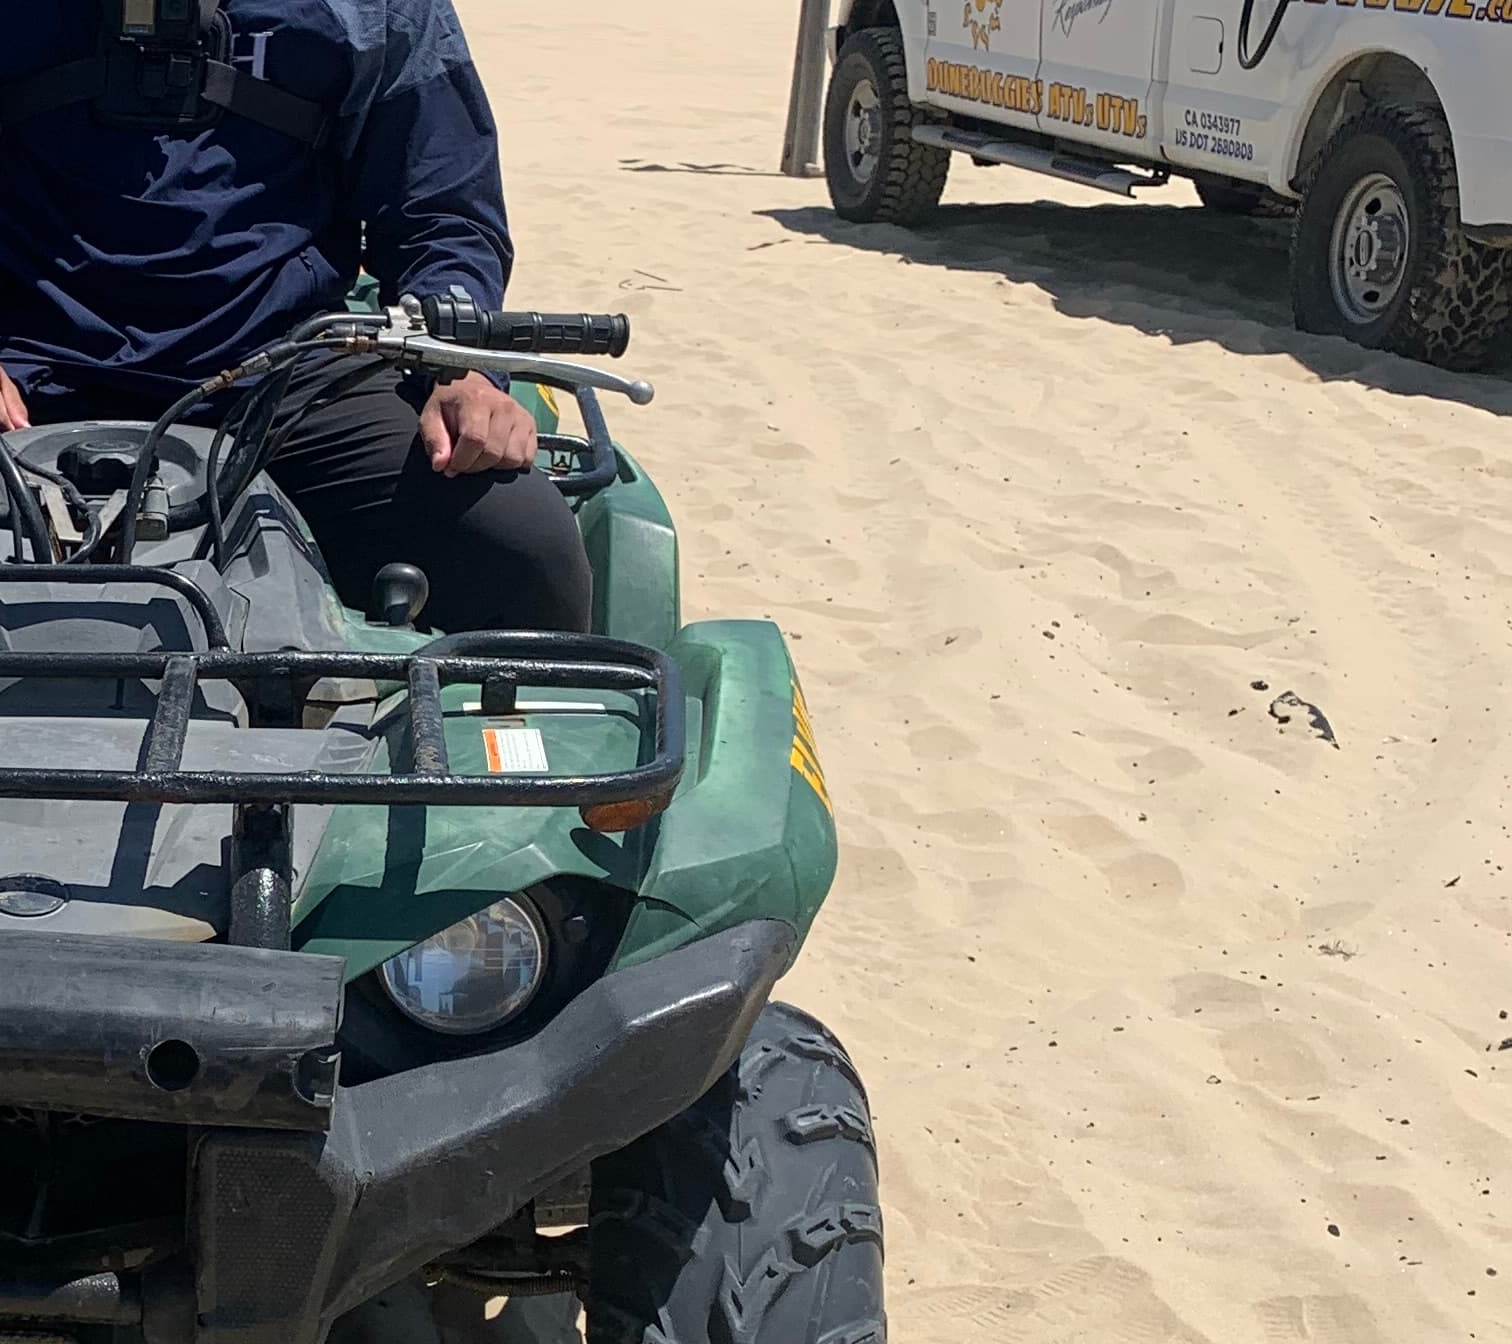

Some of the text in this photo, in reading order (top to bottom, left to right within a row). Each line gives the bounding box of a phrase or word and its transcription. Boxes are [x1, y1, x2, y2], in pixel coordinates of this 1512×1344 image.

[926, 57, 1147, 138] DUNEBUGGIES ATVs UTVs
[1184, 109, 1198, 128] CA
[1175, 128, 1187, 146] US
[1189, 131, 1208, 151] DOT
